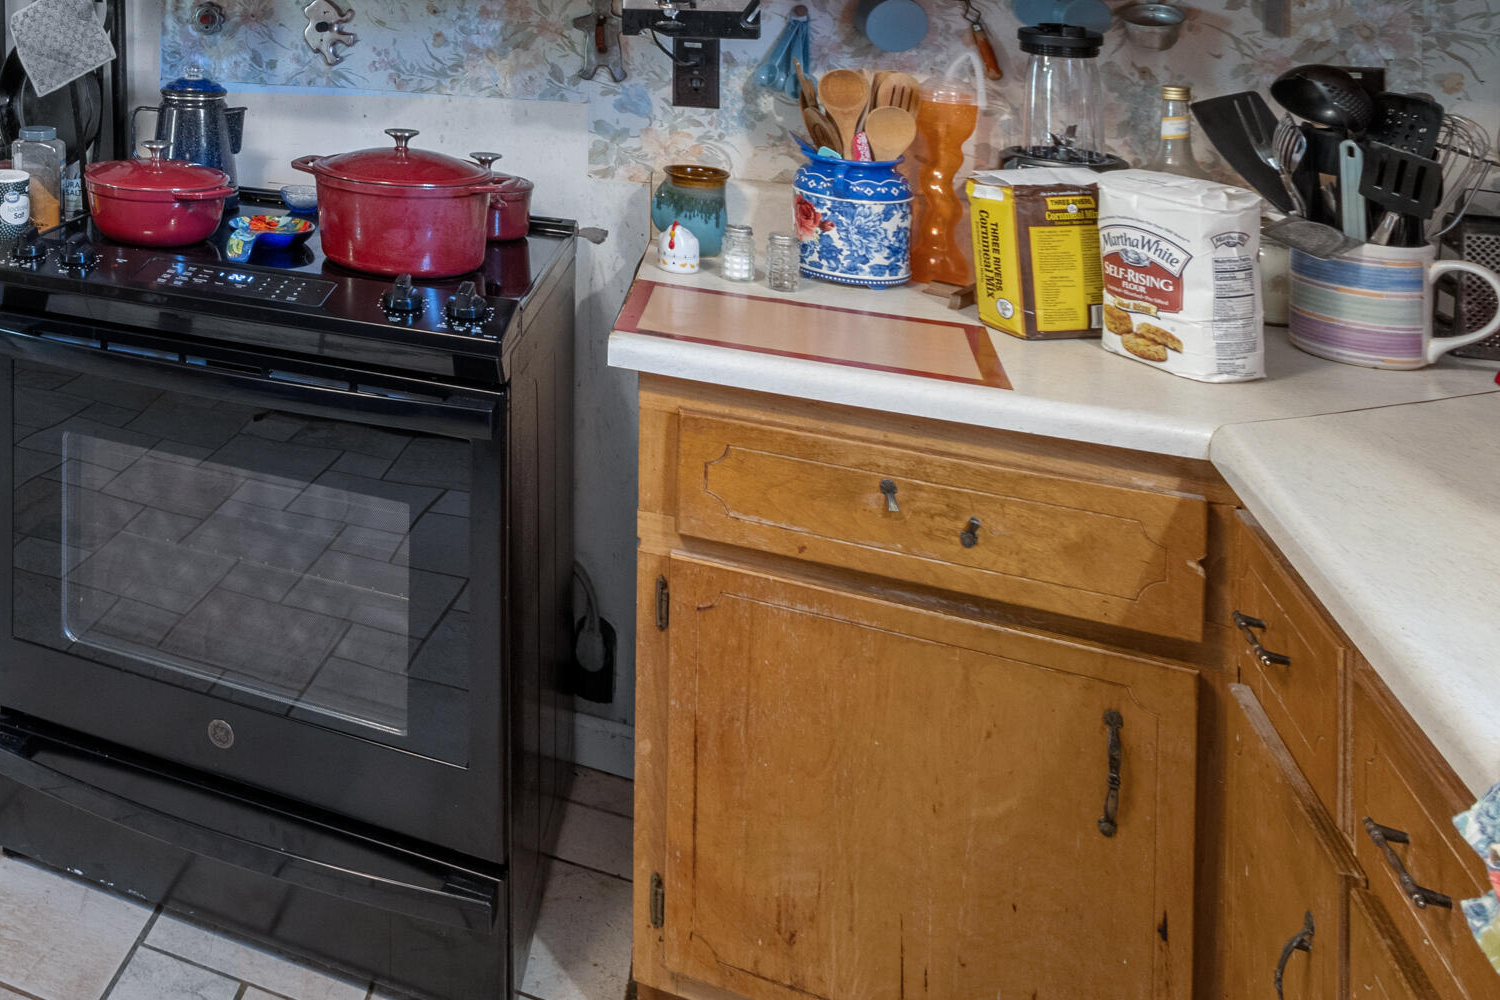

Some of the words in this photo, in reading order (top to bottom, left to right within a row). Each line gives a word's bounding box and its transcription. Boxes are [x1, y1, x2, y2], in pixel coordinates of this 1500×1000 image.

[979, 209, 992, 271] Cornmeal
[990, 222, 1000, 254] THREE
[995, 256, 1003, 291] RIVERS
[1102, 232, 1139, 250] Martha
[1140, 235, 1180, 267] White
[985, 272, 995, 299] Mix
[1104, 261, 1174, 292] SELF-RISING
[1122, 281, 1147, 294] FLOUR
